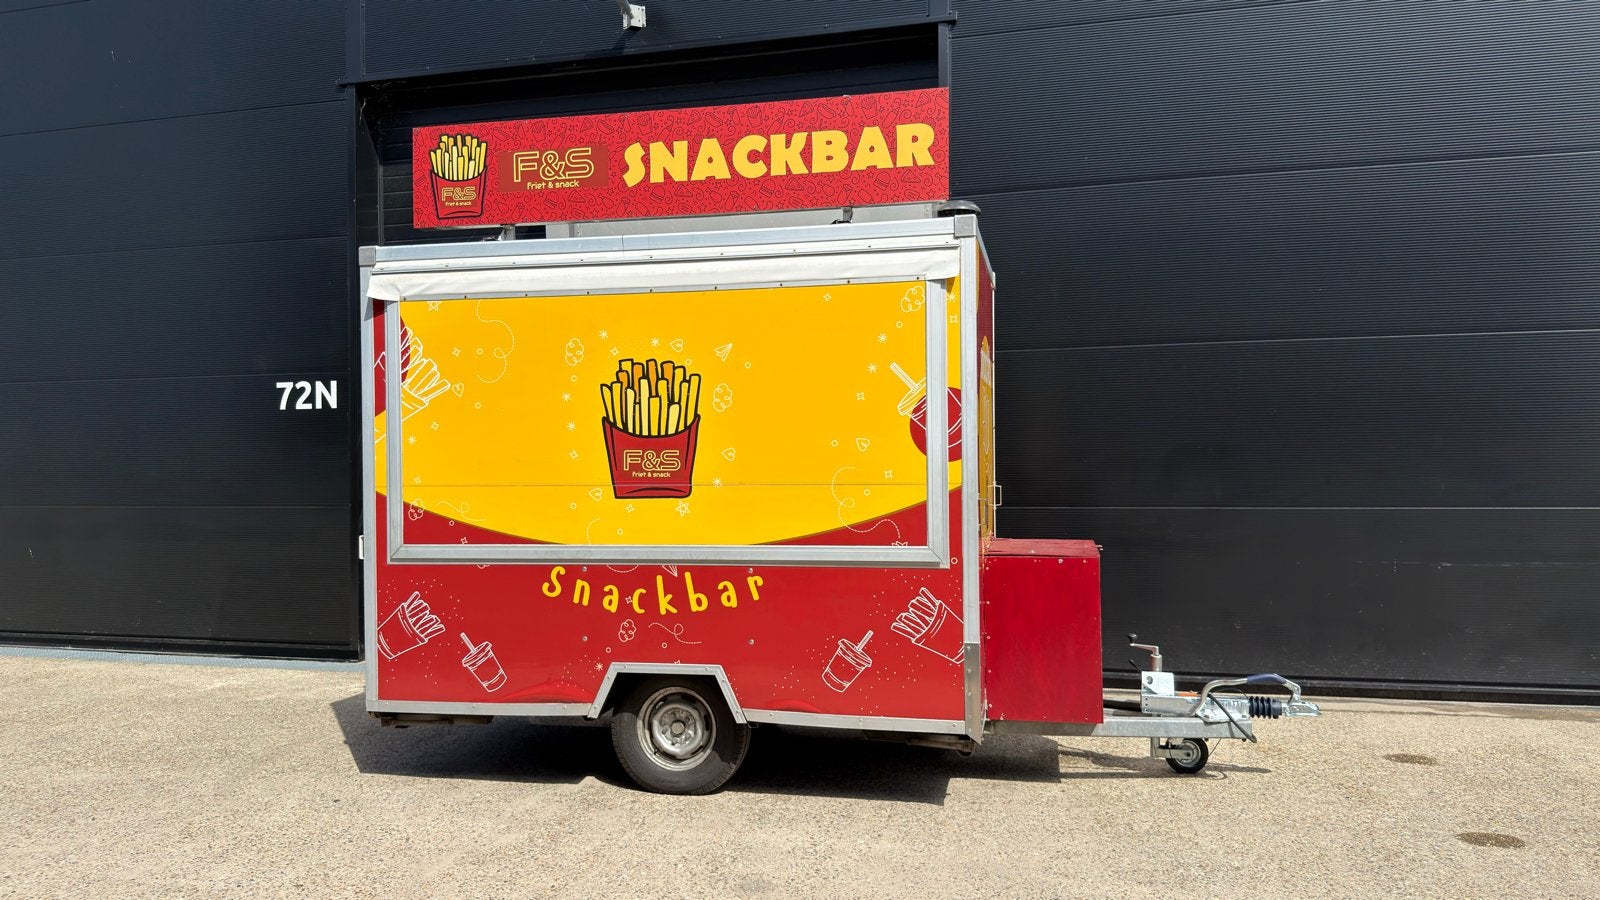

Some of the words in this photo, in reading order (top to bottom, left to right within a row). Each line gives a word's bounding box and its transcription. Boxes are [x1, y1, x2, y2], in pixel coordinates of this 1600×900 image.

[513, 147, 594, 182] F&S
[622, 123, 935, 188] SNACKBAR
[441, 186, 477, 201] F&S
[547, 181, 554, 189] &
[555, 180, 580, 189] snack
[276, 380, 338, 410] 72N
[623, 449, 681, 471] F&S
[542, 565, 764, 615] Snackbar
